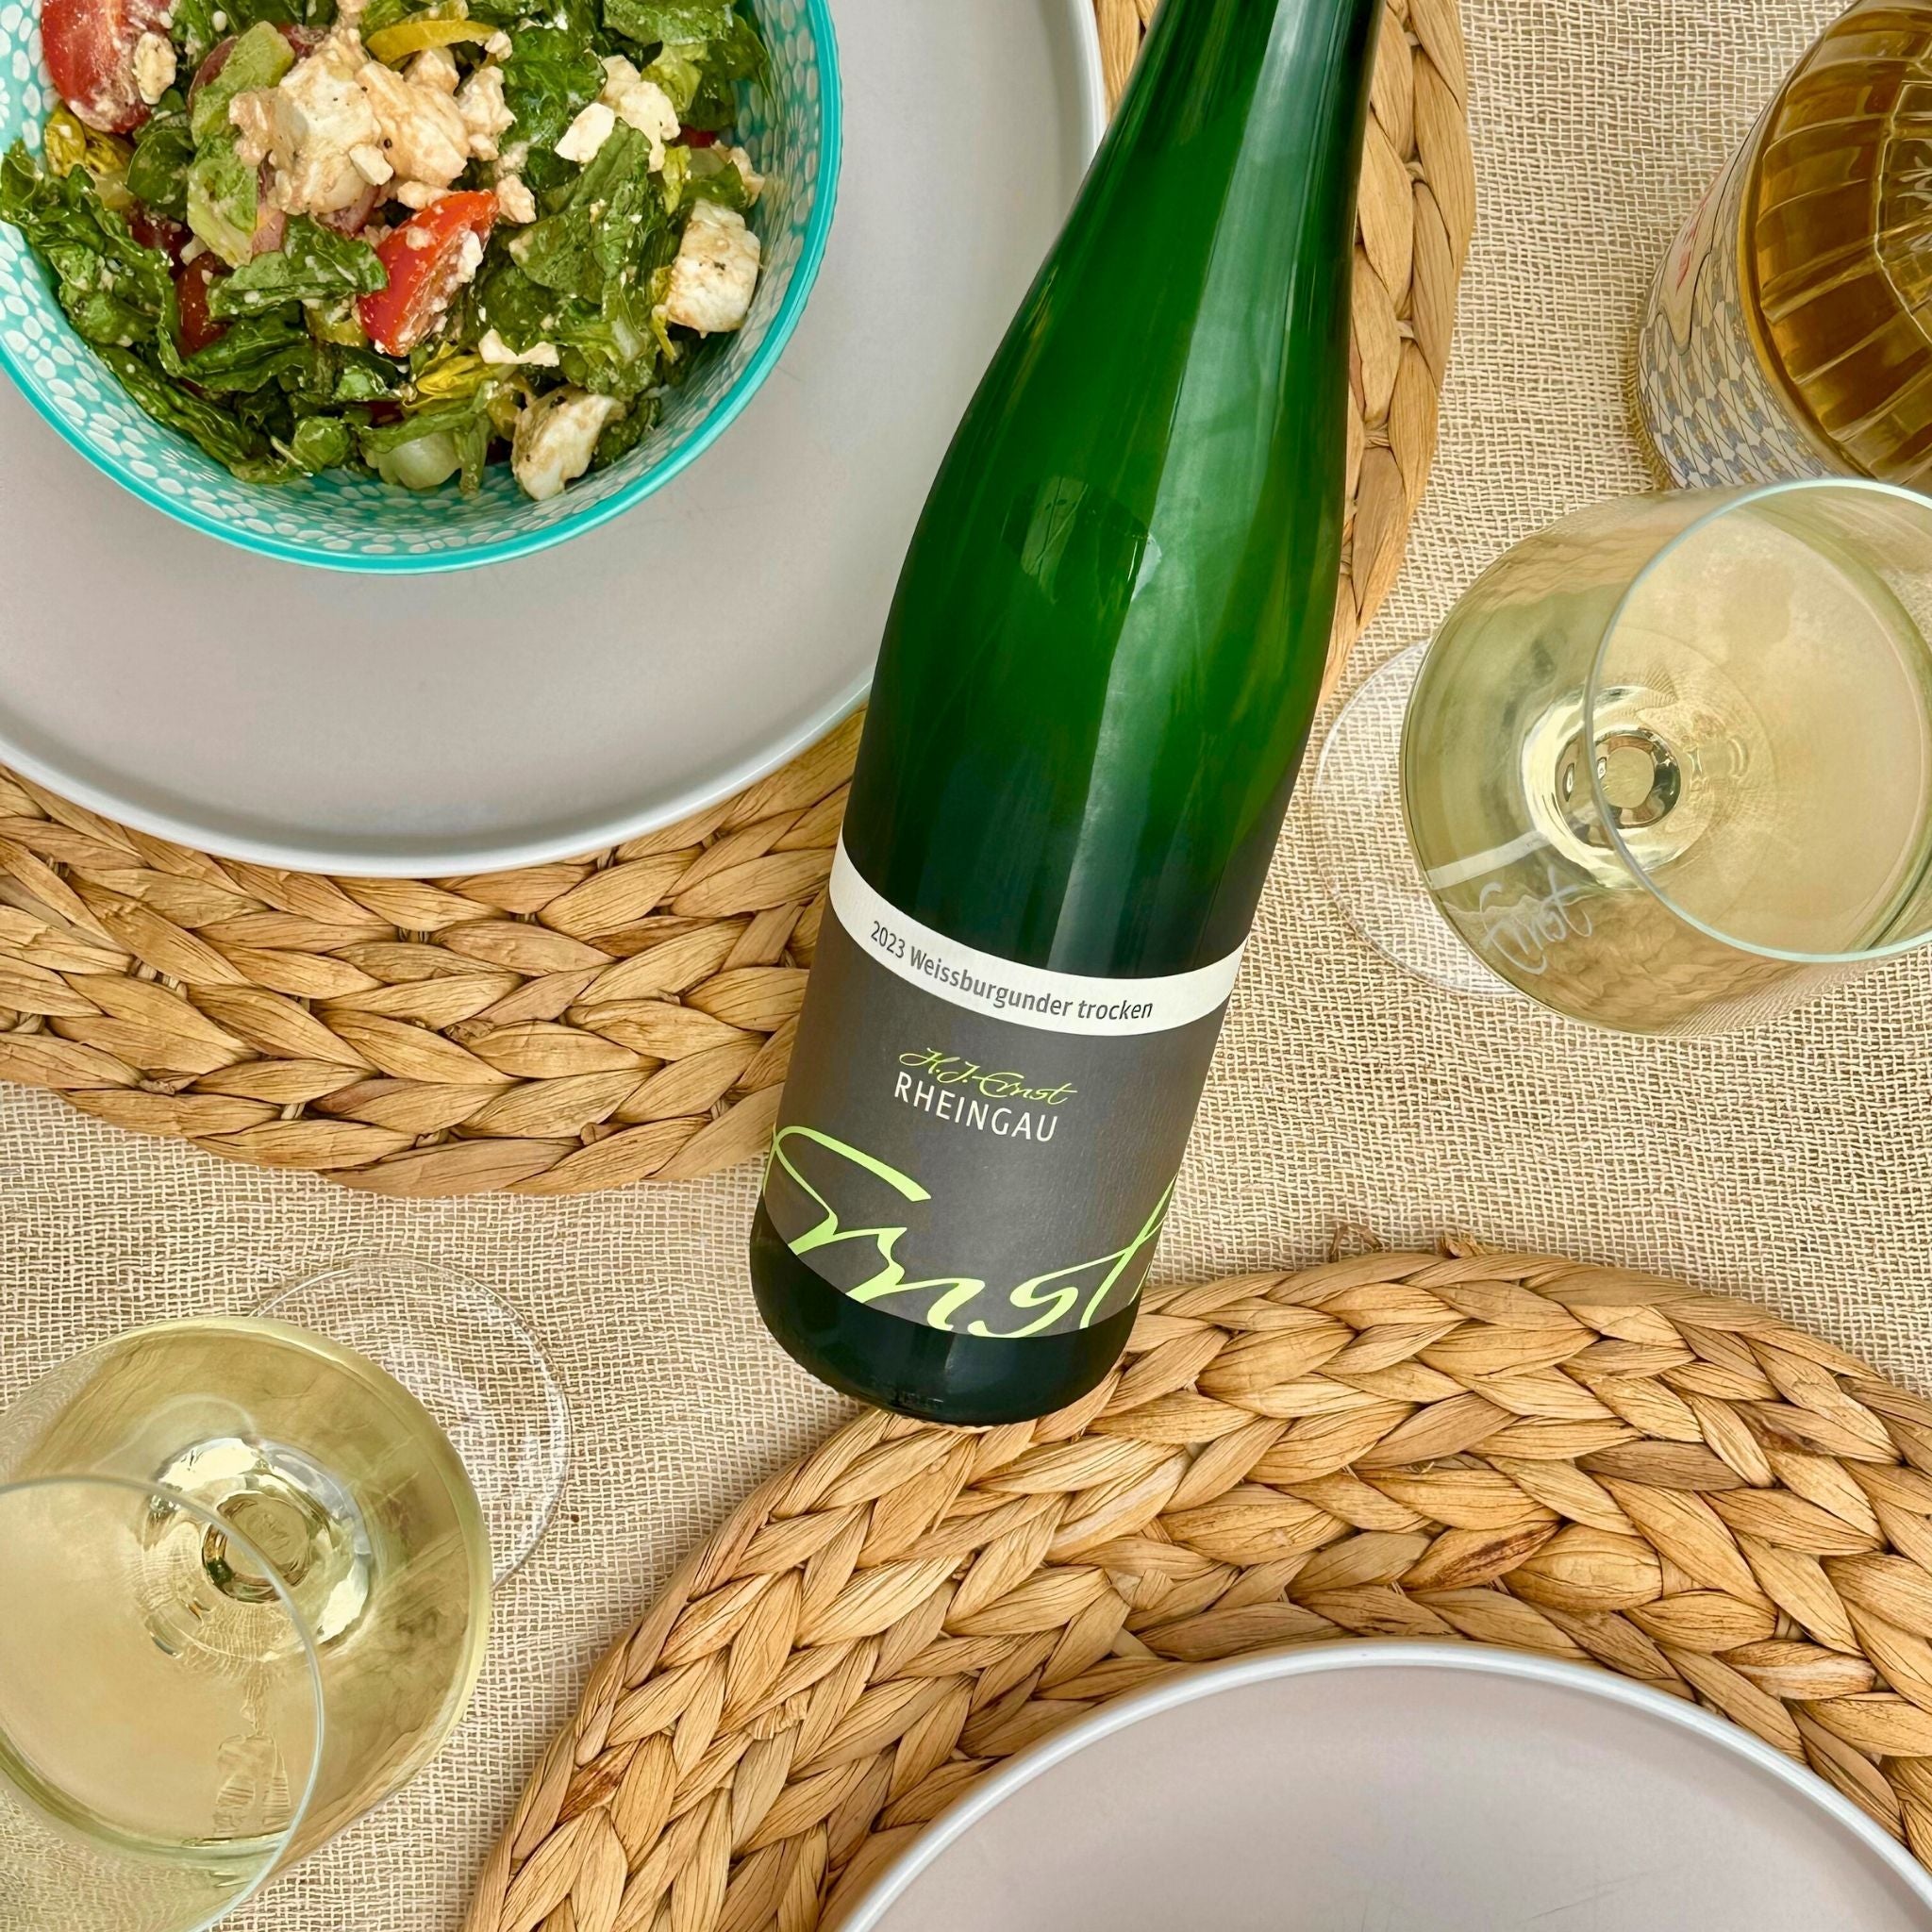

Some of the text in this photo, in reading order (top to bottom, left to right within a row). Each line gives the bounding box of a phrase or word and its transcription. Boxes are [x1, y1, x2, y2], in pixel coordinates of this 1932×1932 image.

[870, 920, 1154, 1021] 2023 Weissburgunder trocken
[894, 1071, 1058, 1142] RHEINGAU
